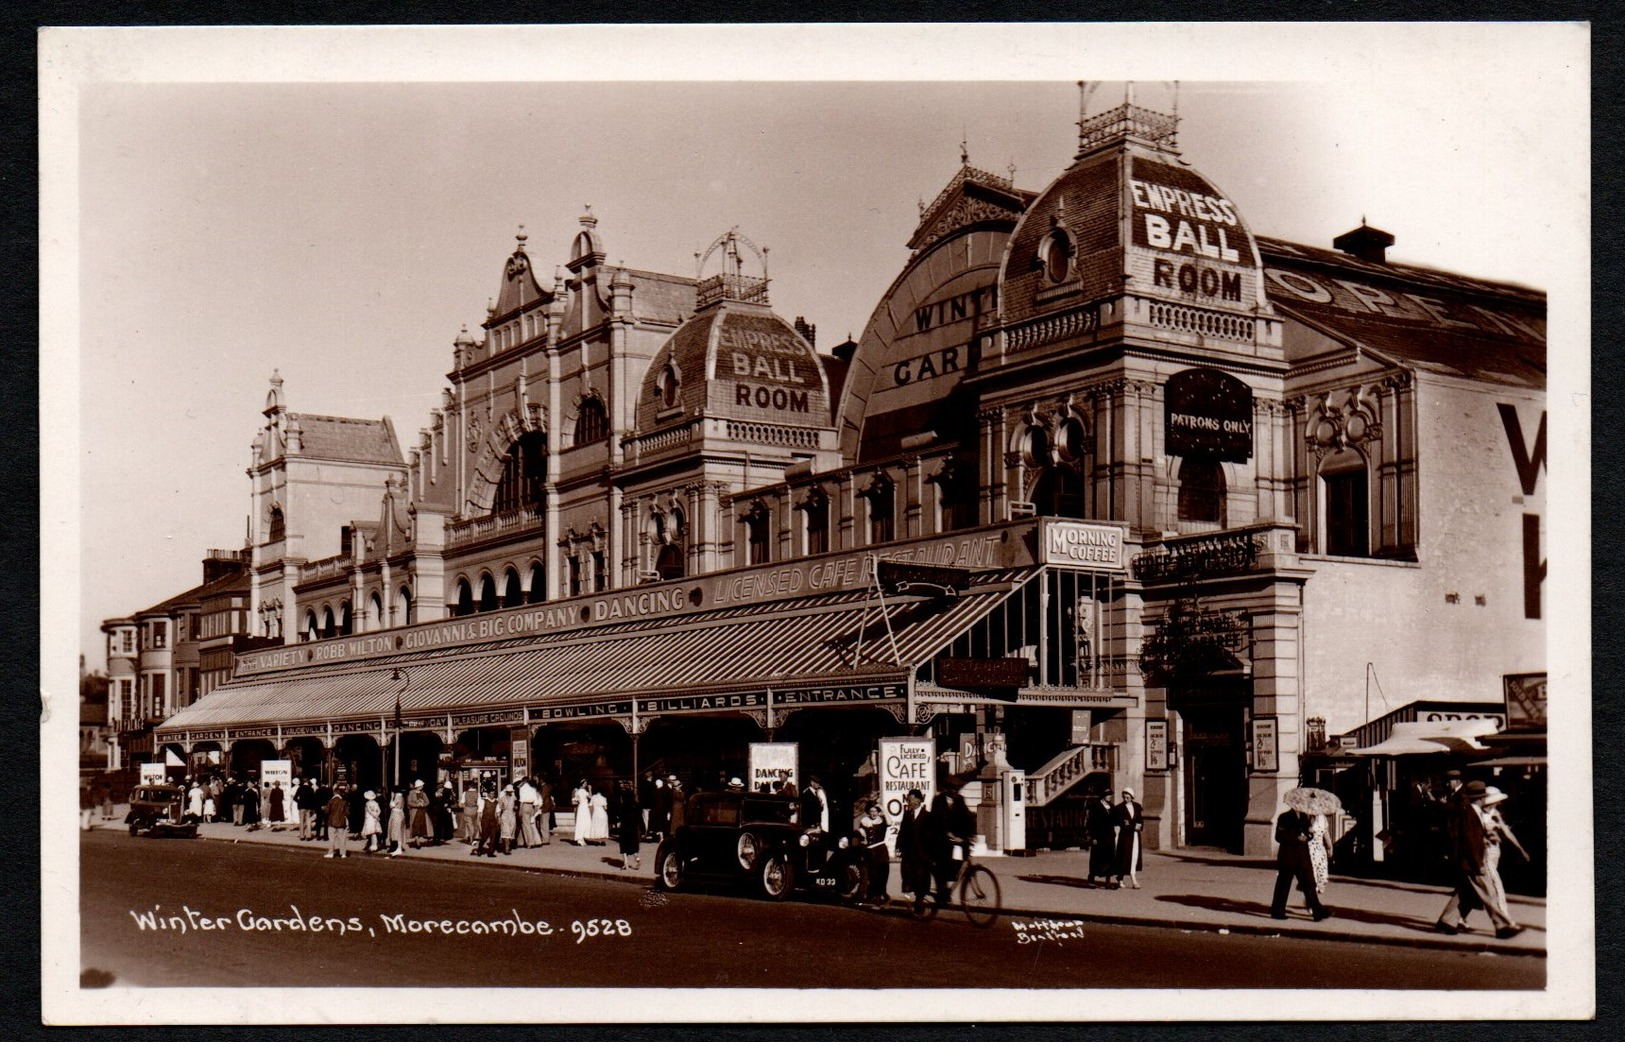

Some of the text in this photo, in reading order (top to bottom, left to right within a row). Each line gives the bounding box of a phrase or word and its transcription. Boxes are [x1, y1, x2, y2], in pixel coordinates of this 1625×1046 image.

[1129, 179, 1237, 226] EMPRESS
[1144, 213, 1240, 262] BALL
[1154, 258, 1241, 302] ROOM
[719, 325, 806, 356] EMPRESS
[732, 352, 804, 383] BALL
[736, 384, 809, 412] ROOM
[1171, 413, 1251, 433] PATRONS ONLY
[1051, 527, 1116, 554] MORNING
[1069, 545, 1116, 562] COFFEE
[714, 567, 803, 603] LICENSED
[809, 558, 857, 590] CAFE
[595, 588, 683, 621] DANCING
[405, 624, 465, 649] GIOVANNI
[480, 617, 503, 637] BIG
[507, 605, 579, 634] COMPANY
[260, 650, 305, 668] VARIETY
[317, 636, 392, 661] ROBB WILTON
[647, 695, 757, 711] BILLIARDS
[785, 686, 898, 702] ENTRANCE
[453, 711, 524, 726] PLEASURE GROUNDS
[542, 704, 618, 719] BOWLING
[235, 728, 272, 738] ENTRANCE
[333, 722, 380, 732] DANCING
[900, 744, 920, 754] FULLY
[886, 781, 930, 791] RESTAURANT
